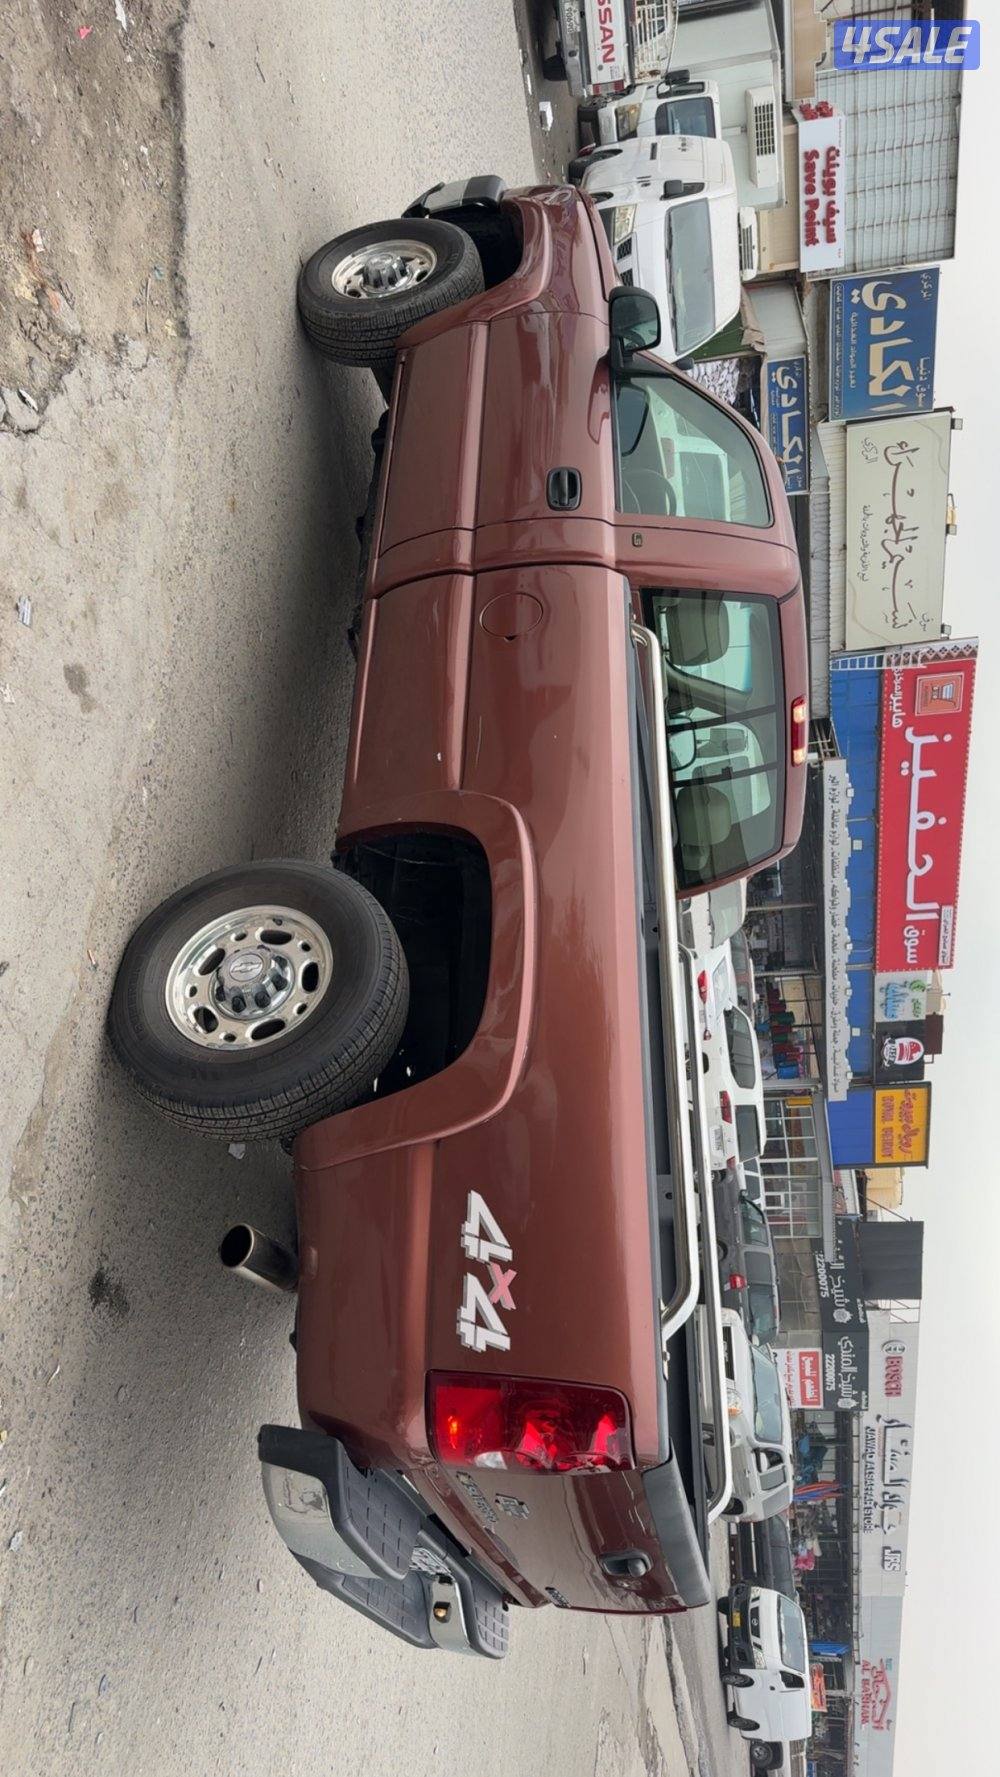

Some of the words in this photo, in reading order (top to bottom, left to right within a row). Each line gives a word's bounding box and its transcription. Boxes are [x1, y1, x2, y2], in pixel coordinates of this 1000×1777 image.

[804, 150, 819, 195] Save
[822, 146, 840, 196] بوينت
[804, 199, 820, 247] Point
[822, 200, 840, 243] سيف
[921, 273, 932, 300] المركزي
[851, 281, 914, 411] الكادي
[915, 384, 930, 407] سوق
[862, 438, 878, 463] المركزي
[922, 613, 933, 631] سوق
[889, 694, 906, 728] هايبر
[901, 727, 952, 920] الحفيز
[903, 924, 927, 963] سوق
[829, 1275, 850, 1308] شيخ
[825, 1354, 835, 1391] 22200075
[839, 1336, 858, 1372] المندي
[838, 1373, 858, 1398] شيخ
[885, 1356, 903, 1397] BOSCH
[863, 1427, 875, 1459] JAWAD
[876, 1414, 912, 1488] الصفار
[864, 1459, 875, 1506] ALSAFFAR
[864, 1507, 874, 1534] STORE
[874, 1492, 905, 1535] جواد
[882, 1546, 901, 1572] JRS
